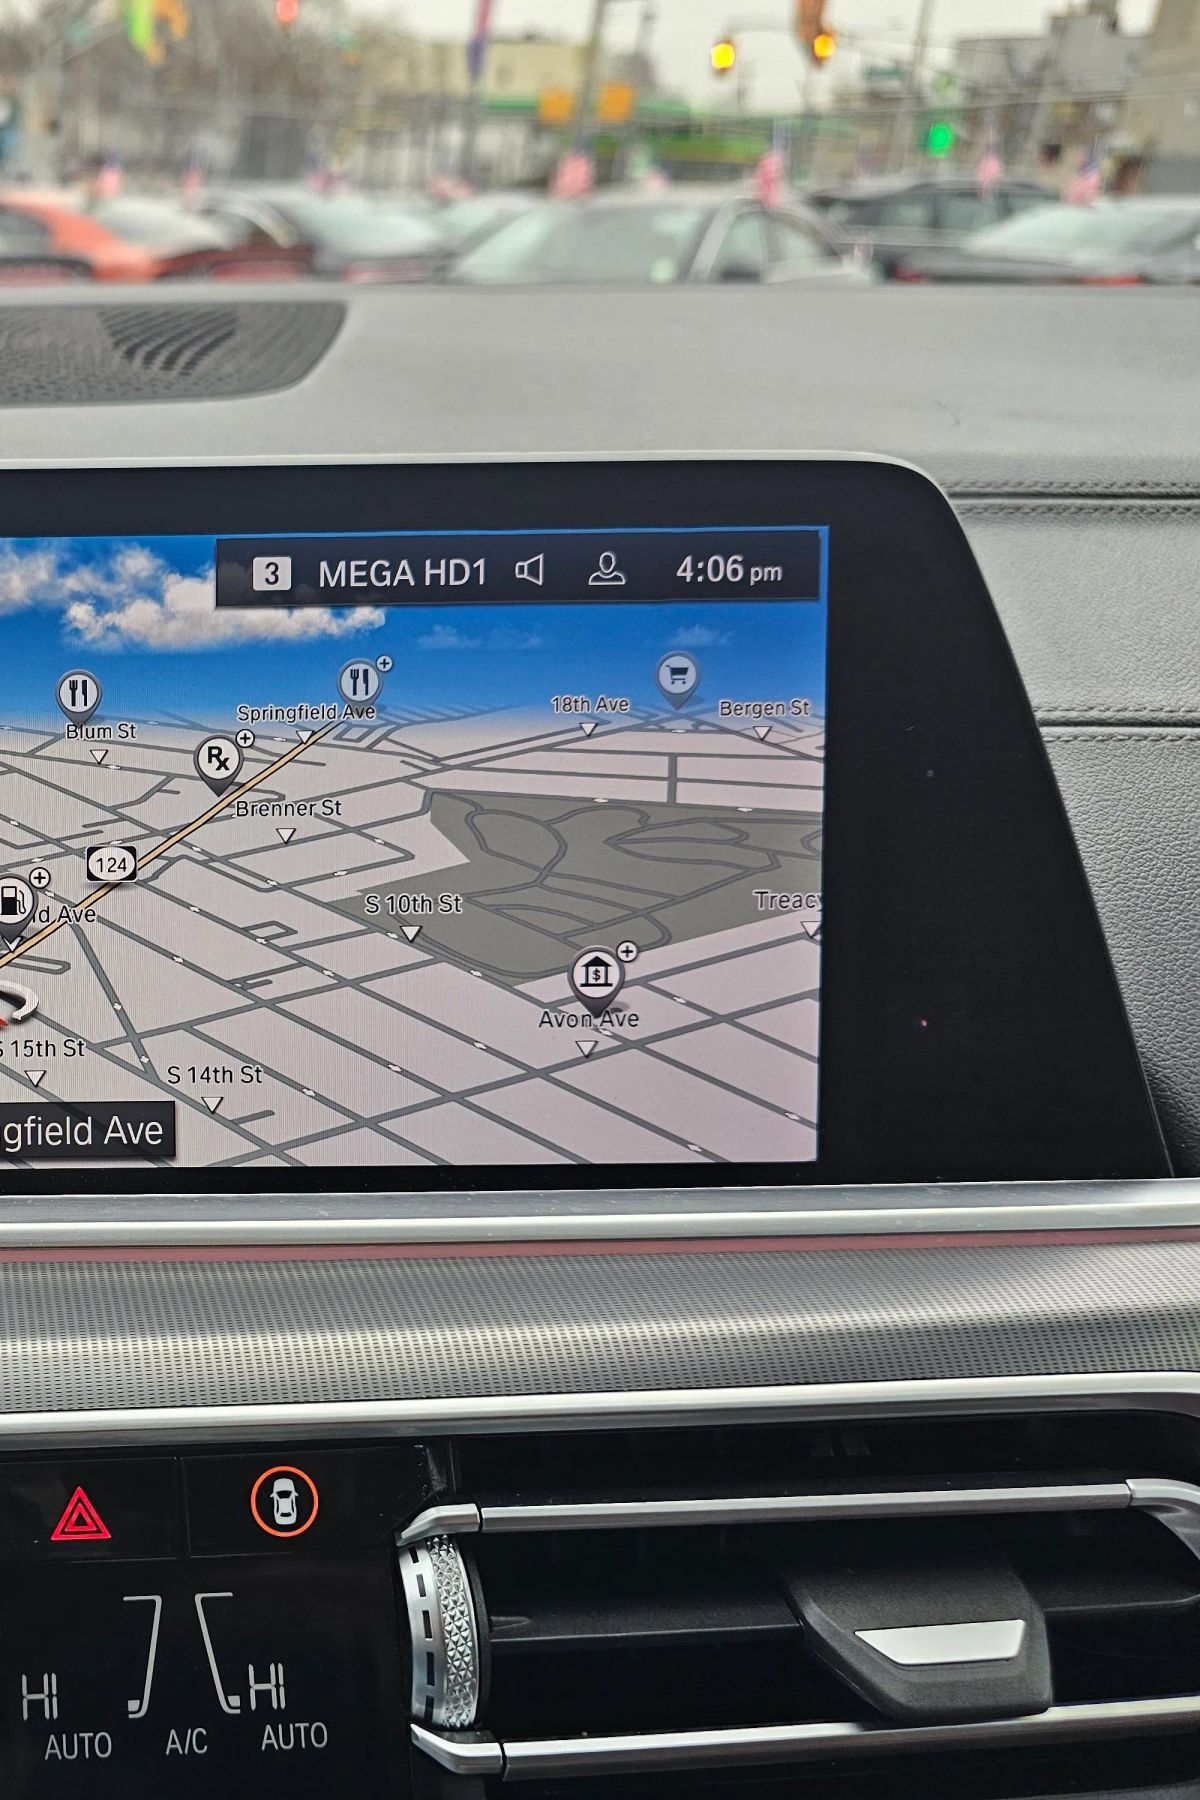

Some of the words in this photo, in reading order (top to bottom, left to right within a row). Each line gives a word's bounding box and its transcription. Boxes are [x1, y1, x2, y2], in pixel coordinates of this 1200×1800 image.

[264, 562, 280, 585] 3
[319, 558, 415, 588] MEGA
[425, 558, 487, 586] HD1
[676, 555, 744, 583] 4:06
[751, 564, 782, 585] pm
[238, 705, 337, 723] Springfield
[342, 705, 375, 720] Ave
[552, 697, 590, 713] 18th
[597, 696, 629, 712] Ave
[720, 700, 784, 720] Bergen
[790, 700, 809, 716] St
[66, 723, 112, 740] Blum
[118, 723, 136, 739] St
[235, 800, 316, 818] Brenner
[322, 799, 341, 817] St
[96, 856, 128, 874] 124
[366, 895, 379, 914] S
[386, 894, 433, 913] 10th
[440, 894, 462, 913] St
[57, 906, 96, 923] Ave
[539, 1010, 592, 1028] Avon
[600, 1010, 639, 1027] Ave
[10, 1039, 58, 1058] 15th
[64, 1039, 86, 1057] St
[167, 1066, 181, 1084] S
[187, 1066, 234, 1084] 14th
[241, 1066, 263, 1083] St
[104, 1118, 163, 1146] Ave
[248, 1663, 286, 1710] HI
[22, 1673, 58, 1721] HI
[45, 1732, 112, 1760] AUTO
[165, 1728, 208, 1755] A/C
[261, 1722, 328, 1751] AUTO
